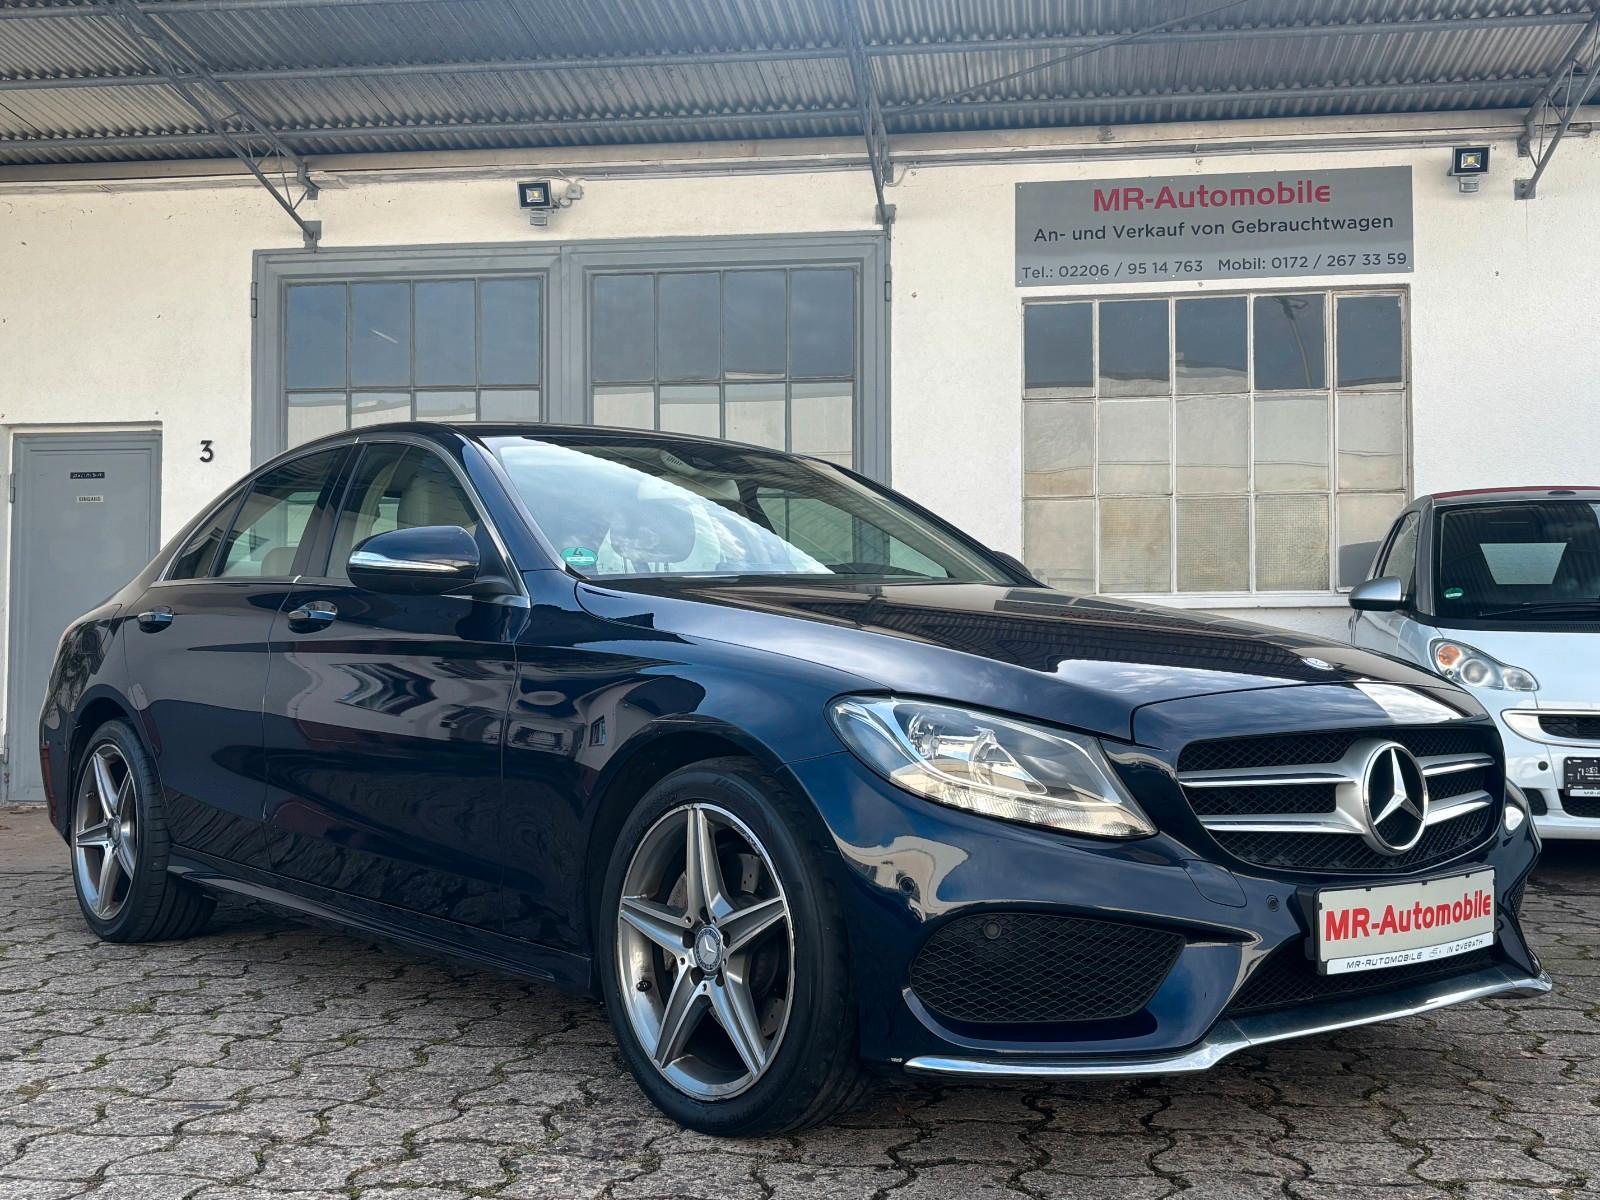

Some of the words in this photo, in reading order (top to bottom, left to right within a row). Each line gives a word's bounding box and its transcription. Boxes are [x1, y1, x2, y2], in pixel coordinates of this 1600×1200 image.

[1093, 179, 1331, 212] MR-Automobile
[1033, 227, 1066, 242] An-
[1072, 225, 1106, 241] und
[1113, 222, 1185, 239] Verkauf
[1190, 222, 1225, 236] von
[1231, 216, 1393, 234] Gebrauchtwagen
[1022, 265, 1053, 279] Tel.:
[1058, 264, 1110, 278] 02206
[1114, 261, 1123, 278] /
[1127, 262, 1147, 275] 95
[1152, 261, 1168, 274] 14
[1174, 260, 1203, 273] 763
[1218, 257, 1266, 271] Mobil:
[1271, 255, 1309, 269] 0172
[1312, 253, 1322, 270] /
[1327, 253, 1356, 267] 267
[1362, 253, 1381, 266] 33
[1387, 252, 1407, 265] 59
[199, 439, 214, 463] 3
[1325, 889, 1492, 942] MR-Automobile
[1346, 951, 1423, 969] MR-AUTOMOBILE
